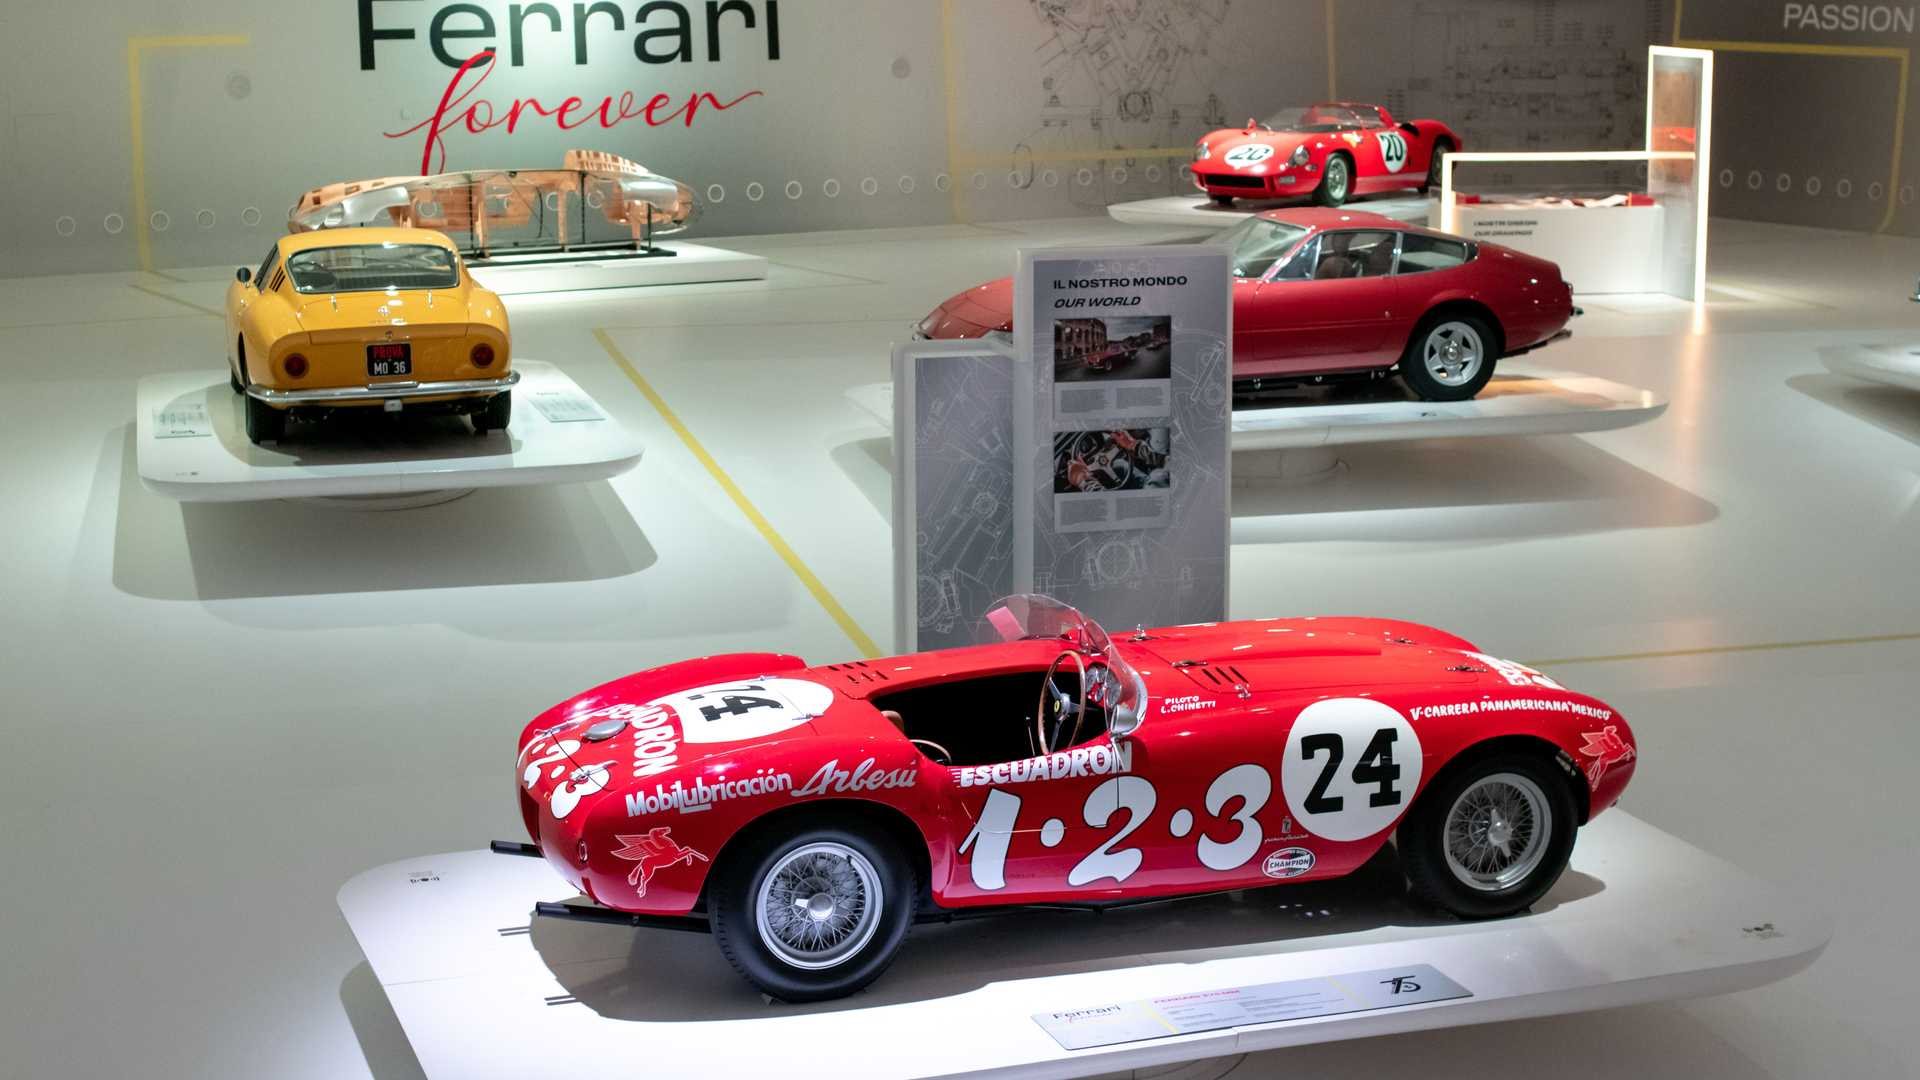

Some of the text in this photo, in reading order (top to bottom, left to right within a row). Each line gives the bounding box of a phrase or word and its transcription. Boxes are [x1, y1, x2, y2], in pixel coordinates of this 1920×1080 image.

[1784, 3, 1914, 32] PASSION
[358, 0, 780, 70] Ferrari
[383, 50, 764, 176] forever
[1379, 133, 1403, 163] 20
[1053, 275, 1188, 289] IL NOSTRO MONDO
[1054, 296, 1142, 309] OUR WORLD
[393, 361, 406, 374] 36
[1165, 695, 1200, 705] PILOTO
[959, 741, 1133, 787] ESCUADRON
[1300, 727, 1402, 815] 24
[1269, 858, 1309, 868] CHAMPION
